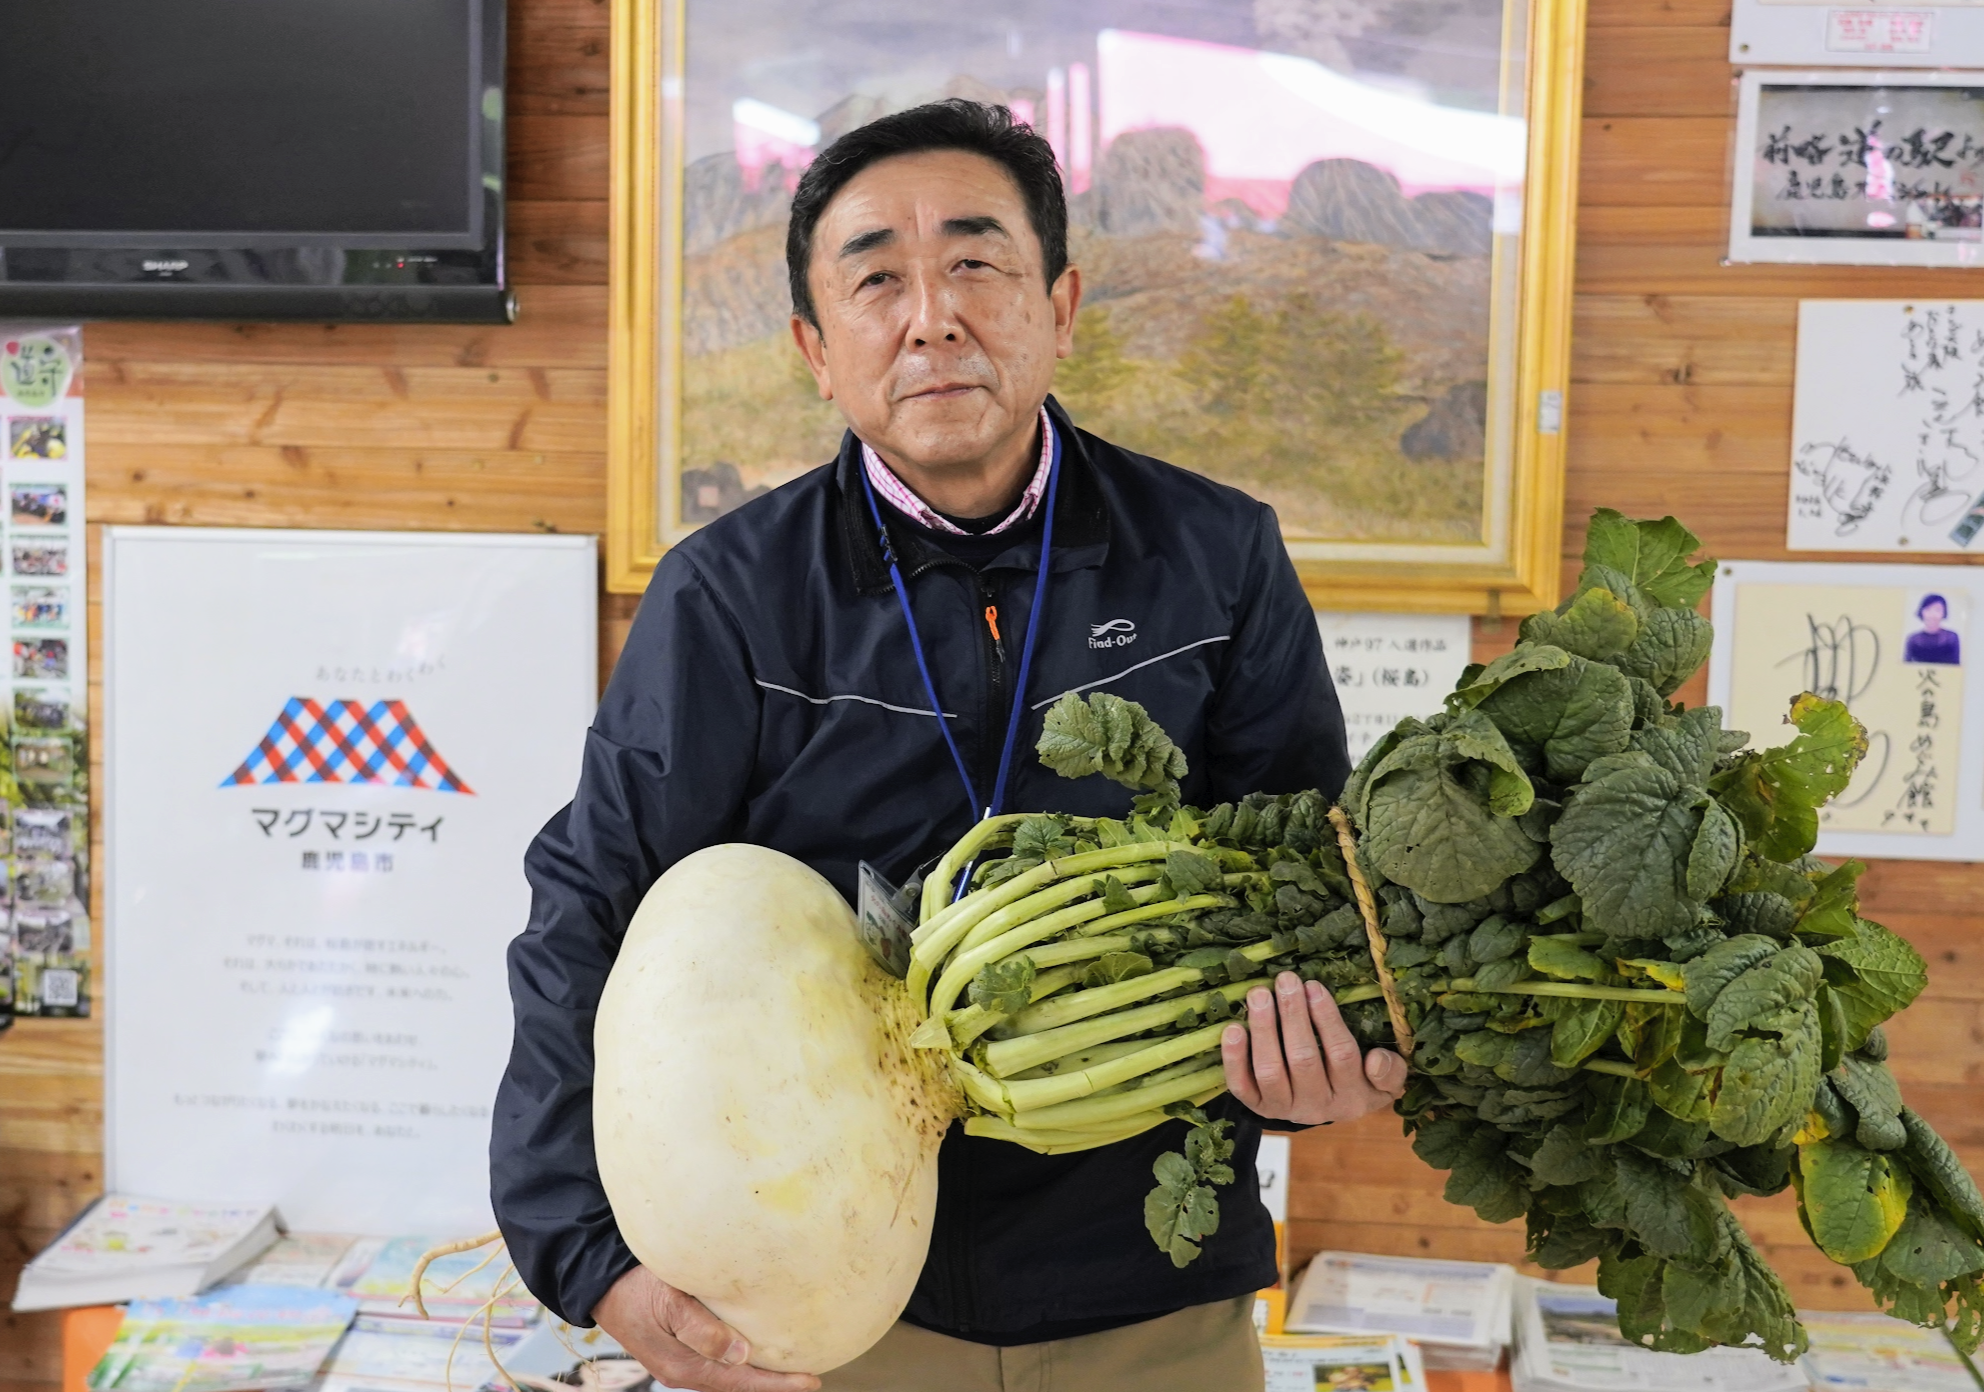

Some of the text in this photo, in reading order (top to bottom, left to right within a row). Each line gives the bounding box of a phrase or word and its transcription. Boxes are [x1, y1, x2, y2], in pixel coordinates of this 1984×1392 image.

[1088, 633, 1138, 649] Find-Out
[250, 807, 445, 843] マグマシティ
[301, 850, 395, 874] 鹿児島市
